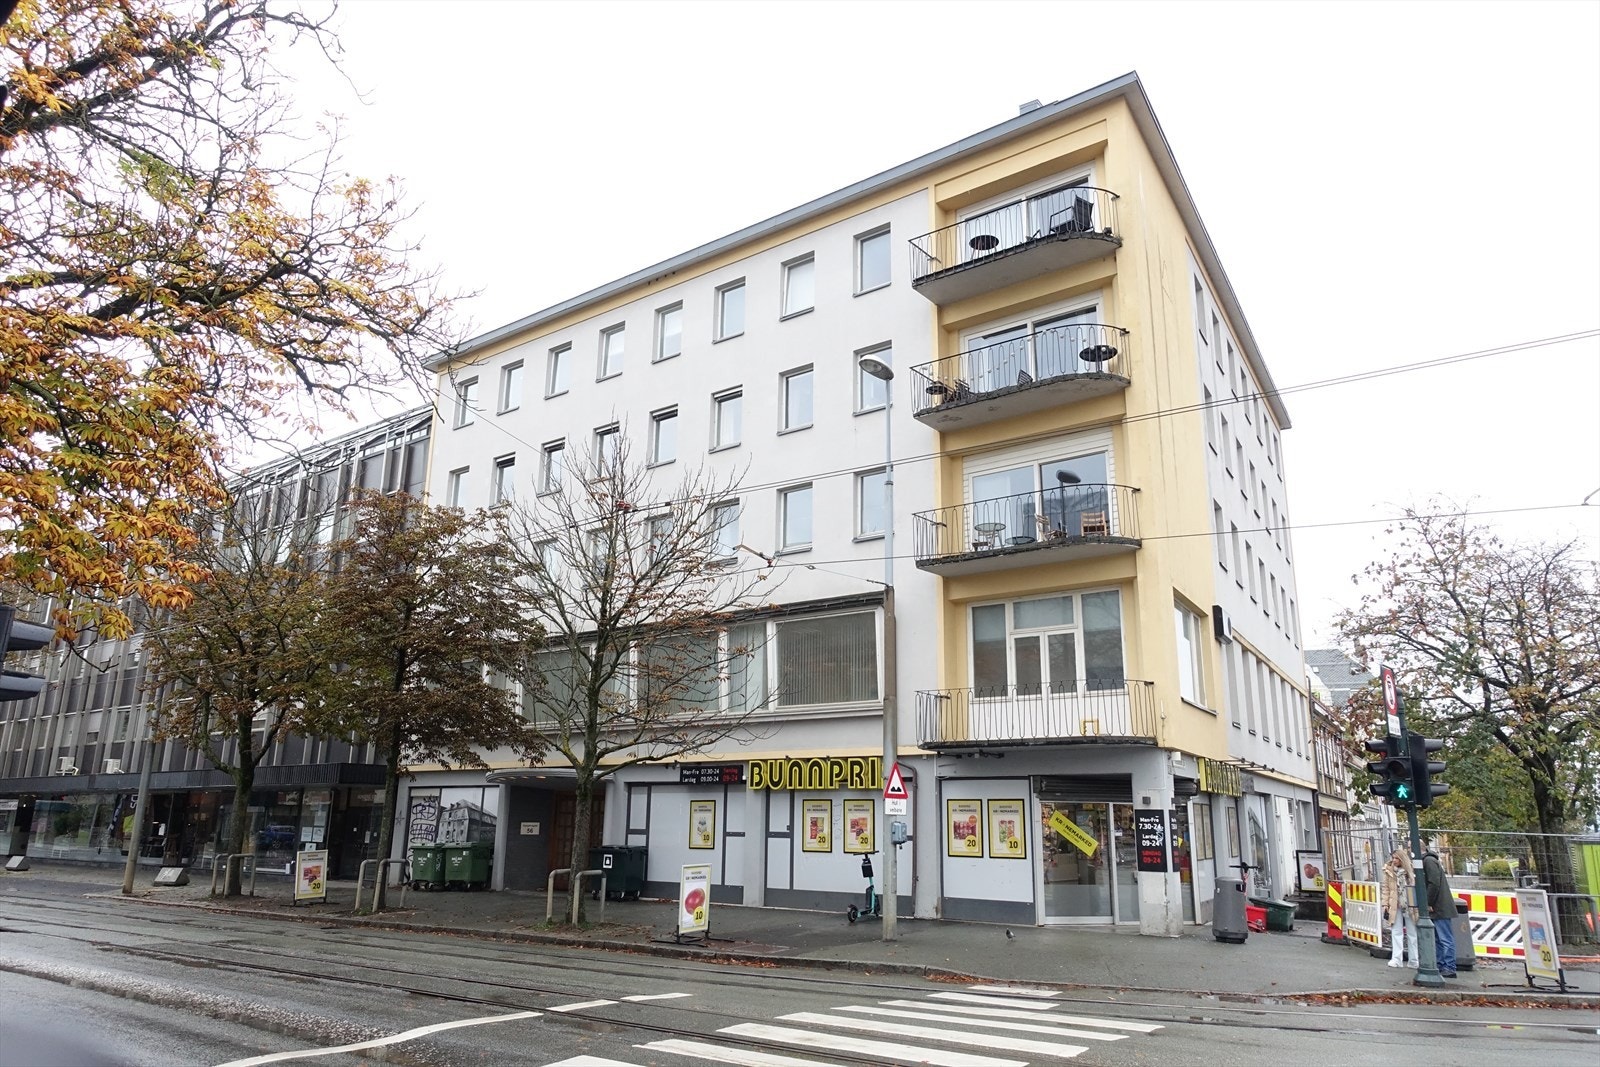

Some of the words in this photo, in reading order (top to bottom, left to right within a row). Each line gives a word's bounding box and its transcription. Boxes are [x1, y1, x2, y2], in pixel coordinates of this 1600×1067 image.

[749, 757, 881, 790] BUNNPRI
[966, 839, 977, 847] 20
[695, 911, 703, 920] 10
[1541, 950, 1551, 962] 20
